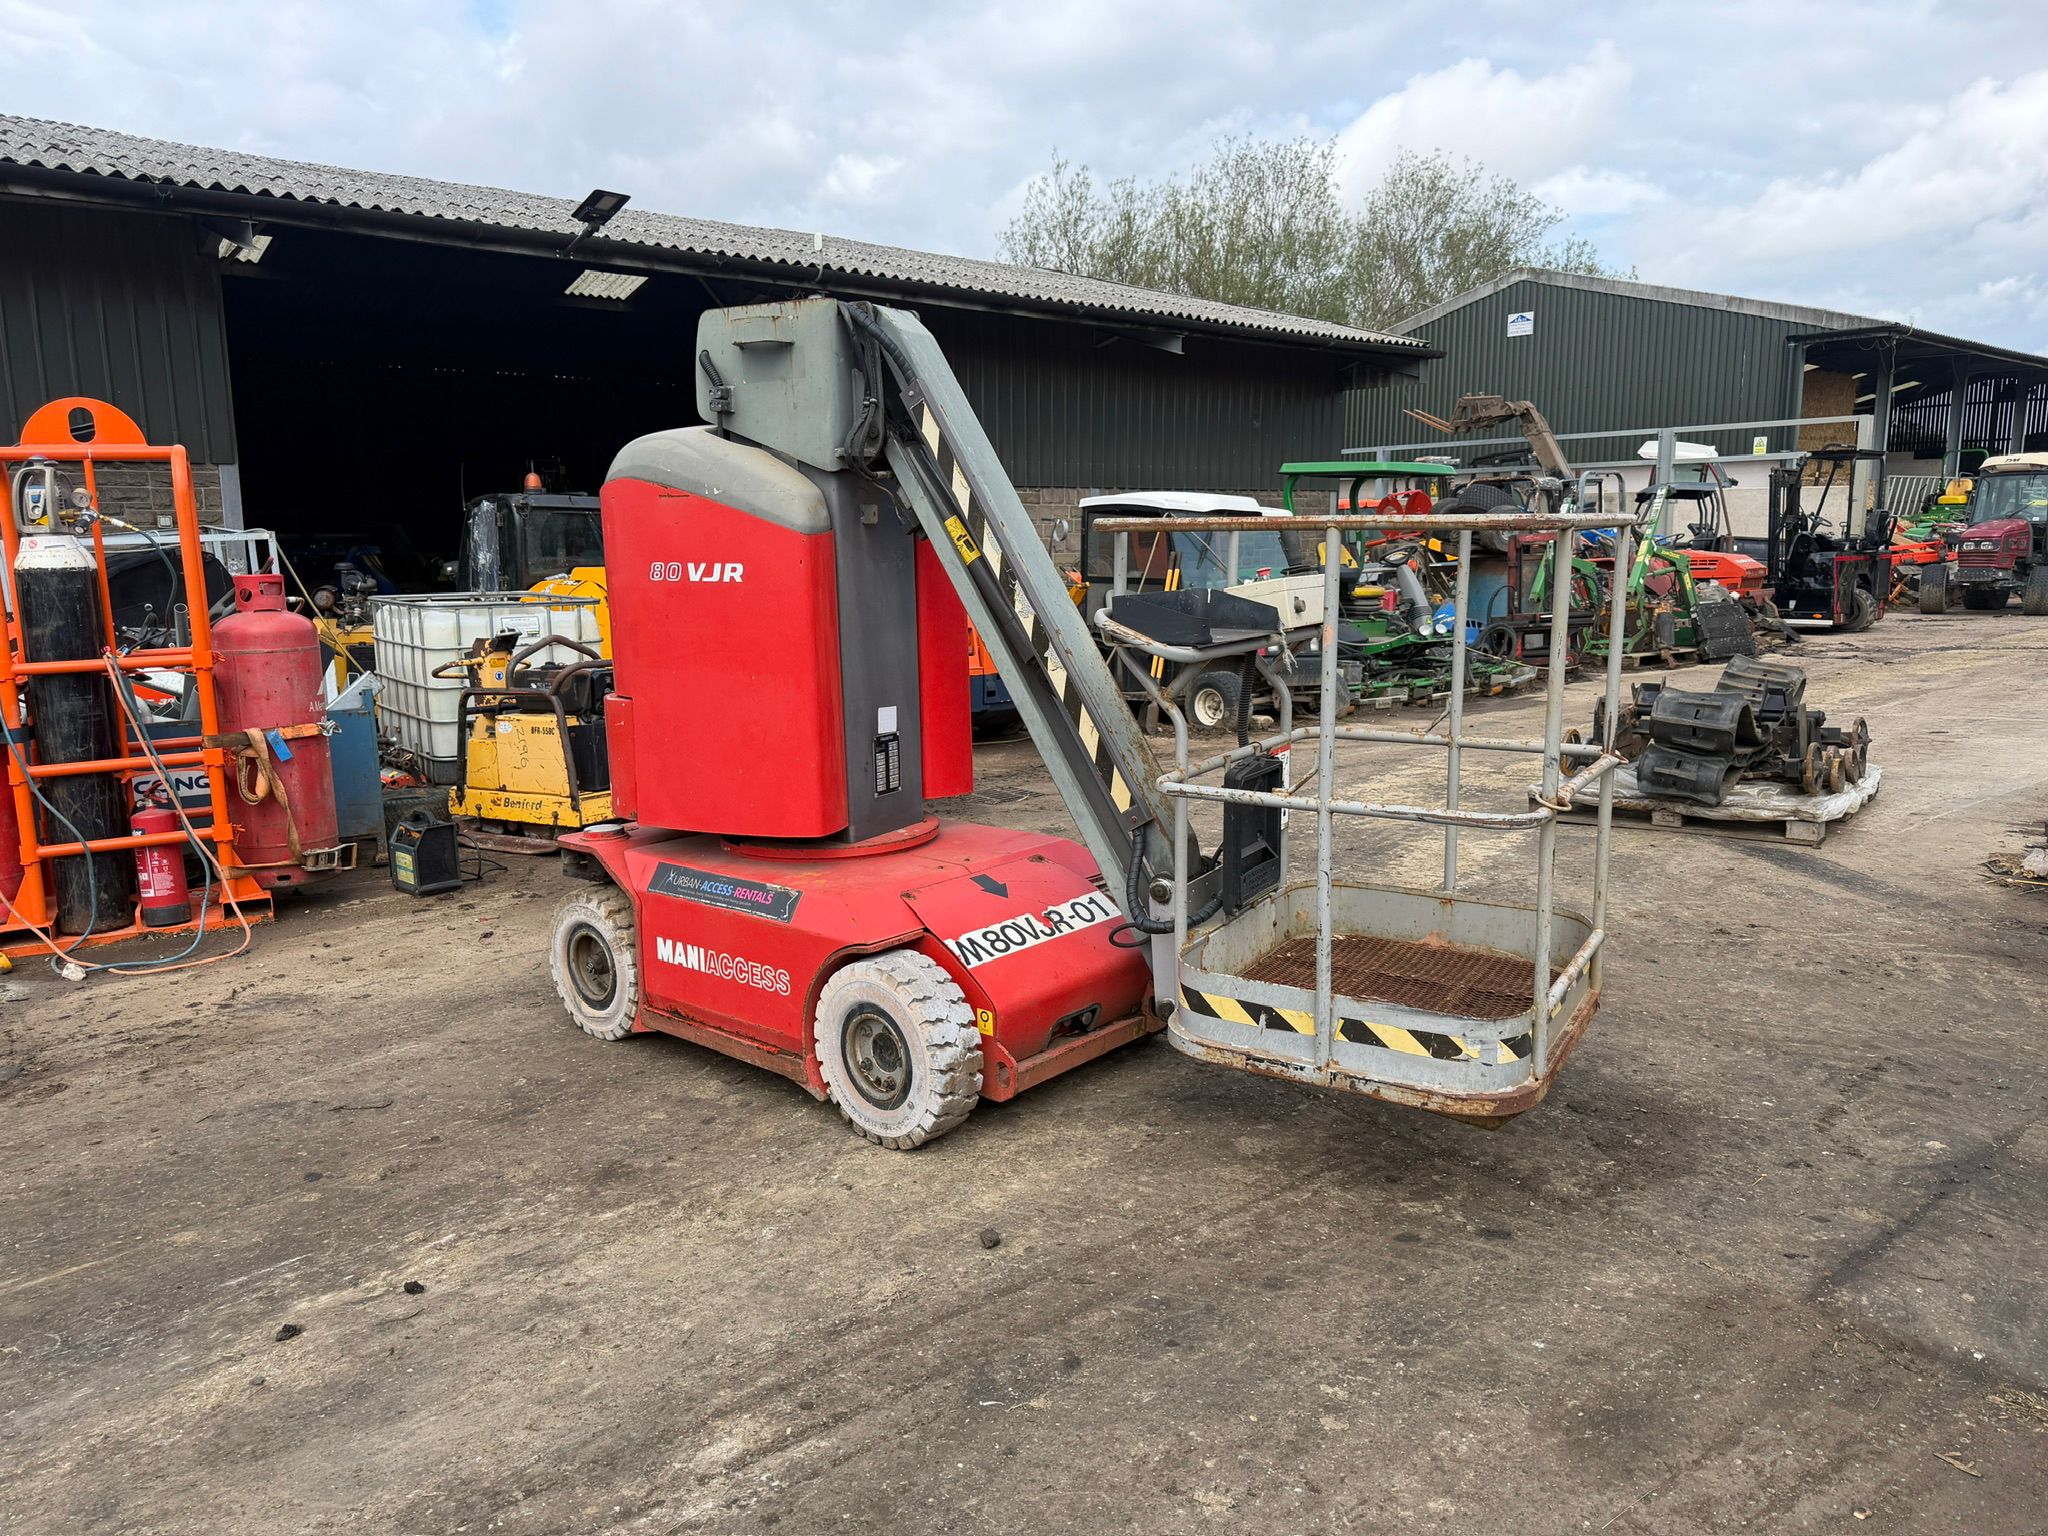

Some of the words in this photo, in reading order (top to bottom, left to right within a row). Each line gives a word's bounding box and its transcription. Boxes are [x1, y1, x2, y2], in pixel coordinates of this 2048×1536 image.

[650, 562, 682, 582] 80
[687, 562, 744, 582] VJR
[656, 936, 791, 996] MANIACCESS
